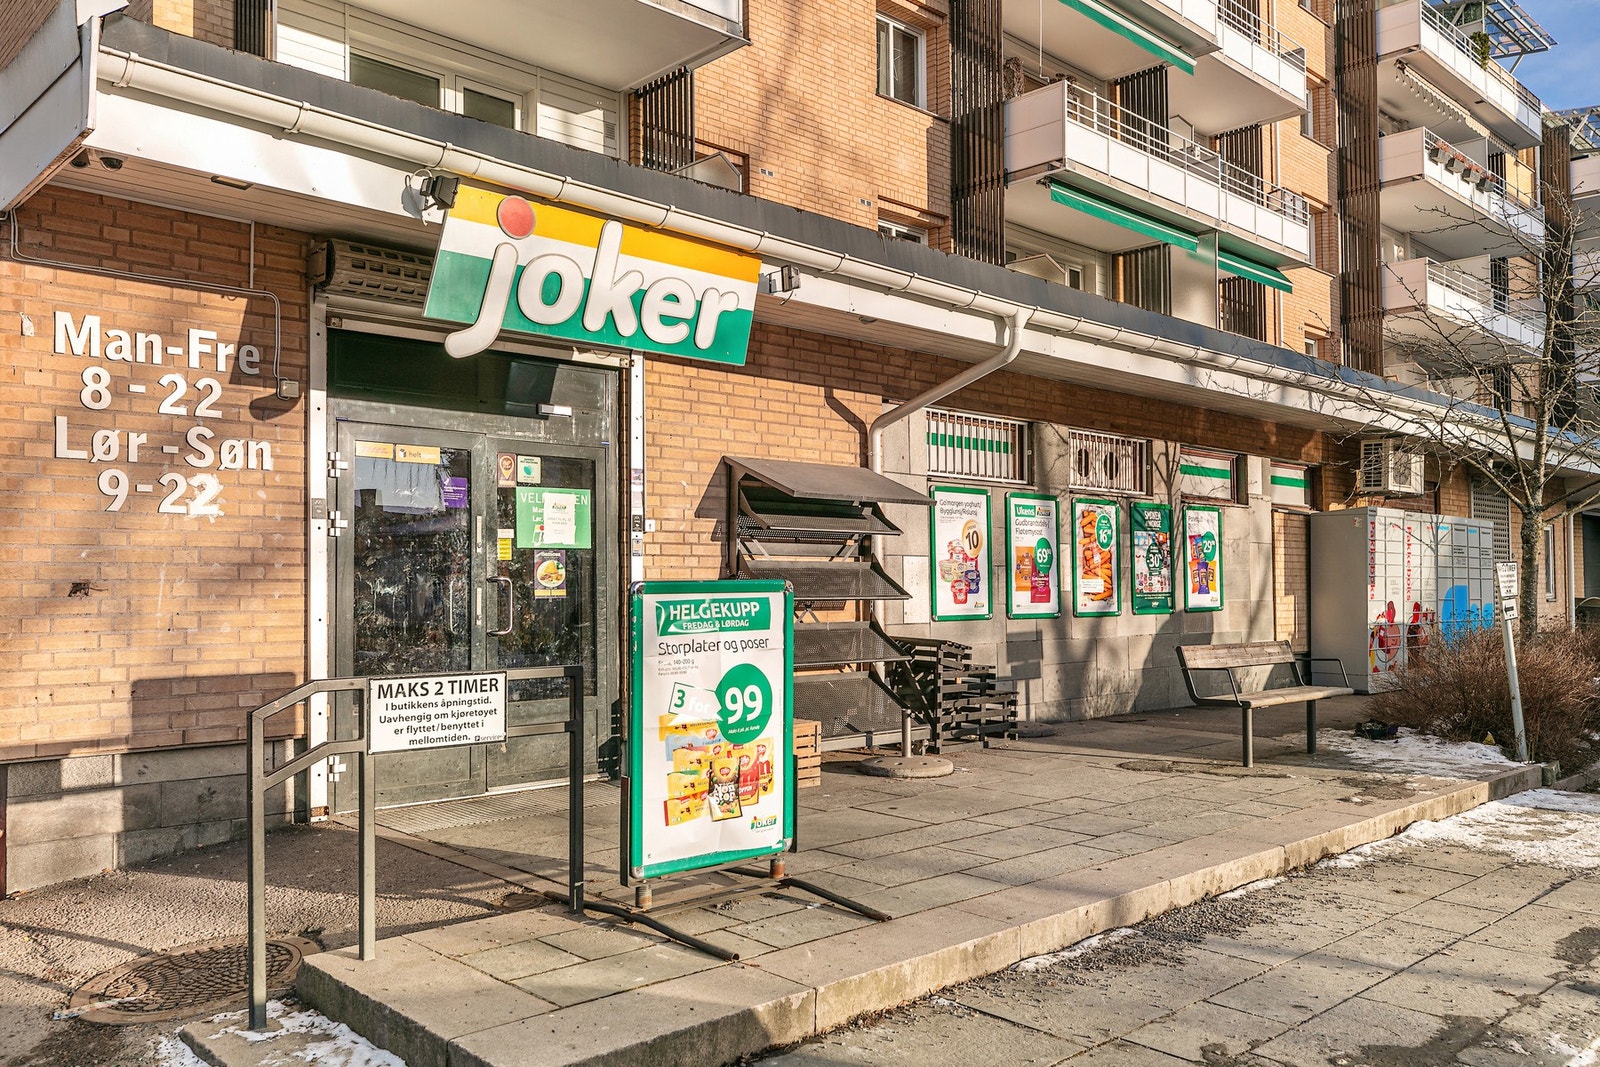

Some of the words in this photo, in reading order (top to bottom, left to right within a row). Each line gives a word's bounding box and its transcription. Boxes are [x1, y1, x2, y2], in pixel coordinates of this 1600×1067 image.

[444, 195, 740, 359] joker
[54, 310, 261, 375] Man-Fre
[520, 492, 588, 505] VELEN
[1016, 506, 1035, 516] Ukens
[965, 530, 979, 550] 10
[669, 601, 760, 620] HELGEKUPP
[682, 620, 713, 630] FREDAG
[721, 619, 749, 627] LØRDAG
[658, 639, 722, 656] Storplater
[723, 642, 738, 653] og
[740, 638, 769, 652] poser
[377, 681, 430, 699] MAKS
[434, 681, 444, 696] 2
[447, 678, 499, 695] TIMER
[391, 699, 439, 711] butikkens
[440, 696, 492, 708] åpningstid.
[673, 689, 686, 708] 3
[688, 696, 710, 713] for
[725, 684, 763, 725] 99
[379, 712, 432, 724] Uavhengig
[434, 712, 449, 720] om
[451, 708, 498, 719] kjøretøyet
[409, 734, 471, 745] mellomtiden.
[712, 782, 736, 794] Non
[712, 791, 736, 805] Stop
[750, 815, 777, 831] joker
